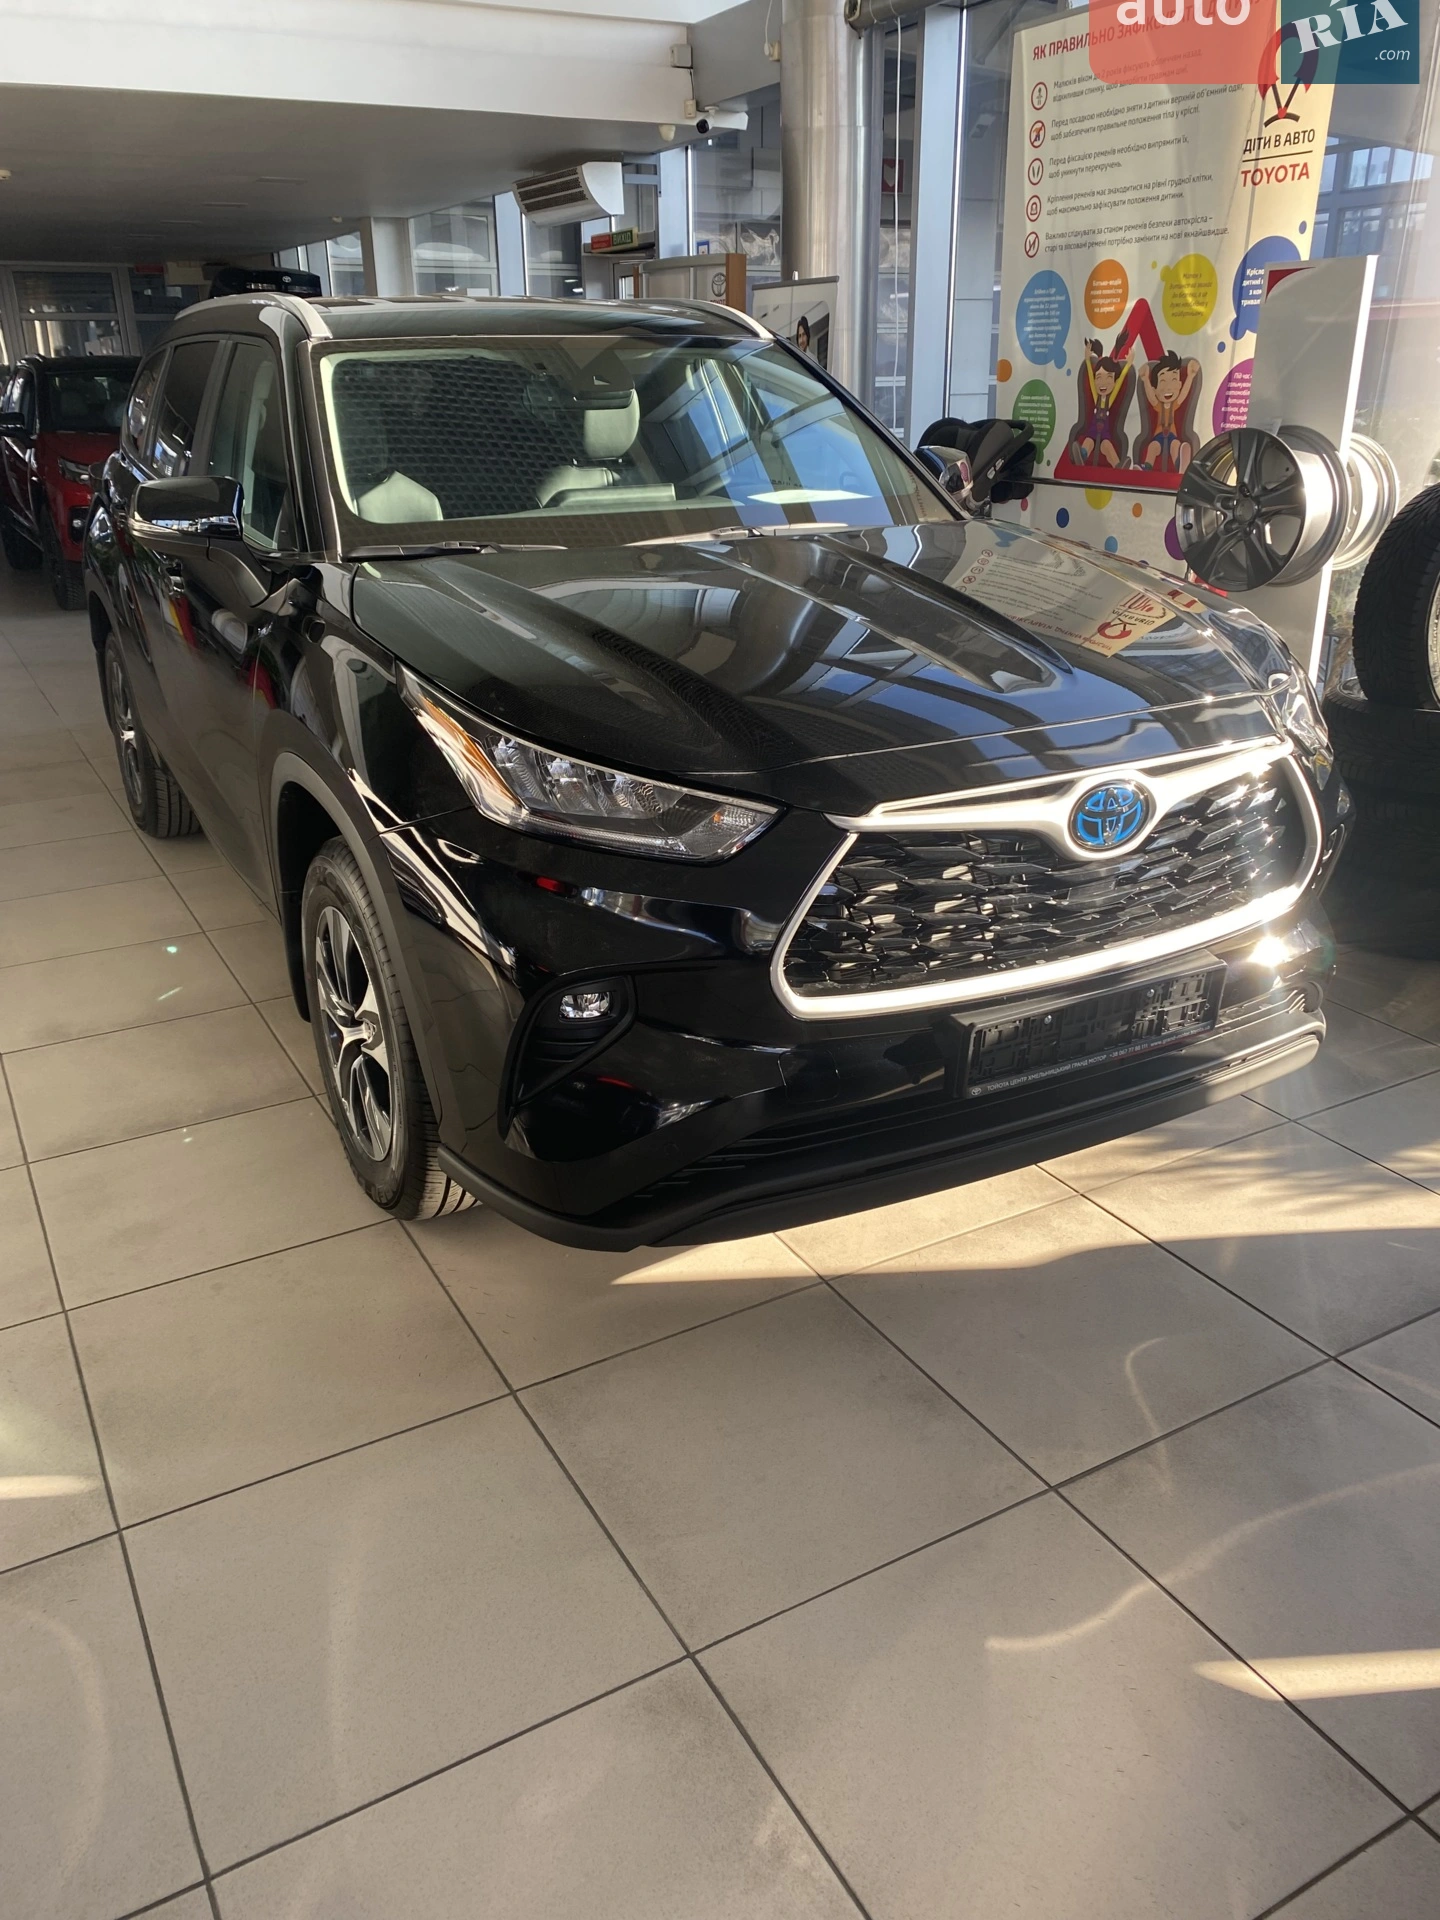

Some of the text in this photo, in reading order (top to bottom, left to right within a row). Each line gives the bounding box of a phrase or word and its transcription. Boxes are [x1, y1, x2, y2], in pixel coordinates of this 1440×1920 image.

[1033, 44, 1047, 60] ЯК
[1049, 26, 1115, 57] ПРАВИЛЬНО
[1053, 76, 1076, 88] Малюків
[1052, 118, 1068, 128] Перед
[1069, 113, 1095, 124] посадкою
[1096, 106, 1125, 118] необхідно
[1126, 103, 1143, 113] зняти
[1147, 98, 1170, 110] дитини
[1171, 91, 1195, 105] верхній
[1051, 132, 1062, 141] щоб
[1063, 126, 1096, 139] забезпечити
[1096, 120, 1127, 133] правильне
[1128, 113, 1161, 126] положення
[1162, 109, 1175, 119] тіла
[1049, 157, 1066, 166] Перед
[1093, 147, 1116, 160] ременів
[1117, 142, 1146, 154] необхідно
[1244, 128, 1316, 155] ДІТИ В АВТО
[1048, 170, 1060, 178] щоб
[1241, 162, 1310, 188] TOYOTA
[1074, 189, 1095, 201] ременів
[1107, 183, 1142, 194] знаходитися
[1152, 178, 1166, 190] рівні
[1167, 175, 1192, 188] грудної
[1047, 207, 1058, 216] щоб
[1059, 204, 1092, 214] максимально
[1093, 199, 1126, 210] зафіксувати
[1127, 195, 1160, 205] положення
[613, 231, 632, 245] ВИХІД
[1046, 232, 1067, 240] Важливо
[1148, 220, 1172, 229] безпеки
[1108, 236, 1133, 246] потрібно
[1134, 234, 1160, 244] замінити
[1170, 230, 1182, 240] нові
[987, 1082, 1009, 1091] ТОЙОТА
[1010, 1076, 1028, 1086] ЦЕНТР
[1072, 1059, 1088, 1069] ГРАНД
[1088, 1054, 1107, 1064] МОТОР
